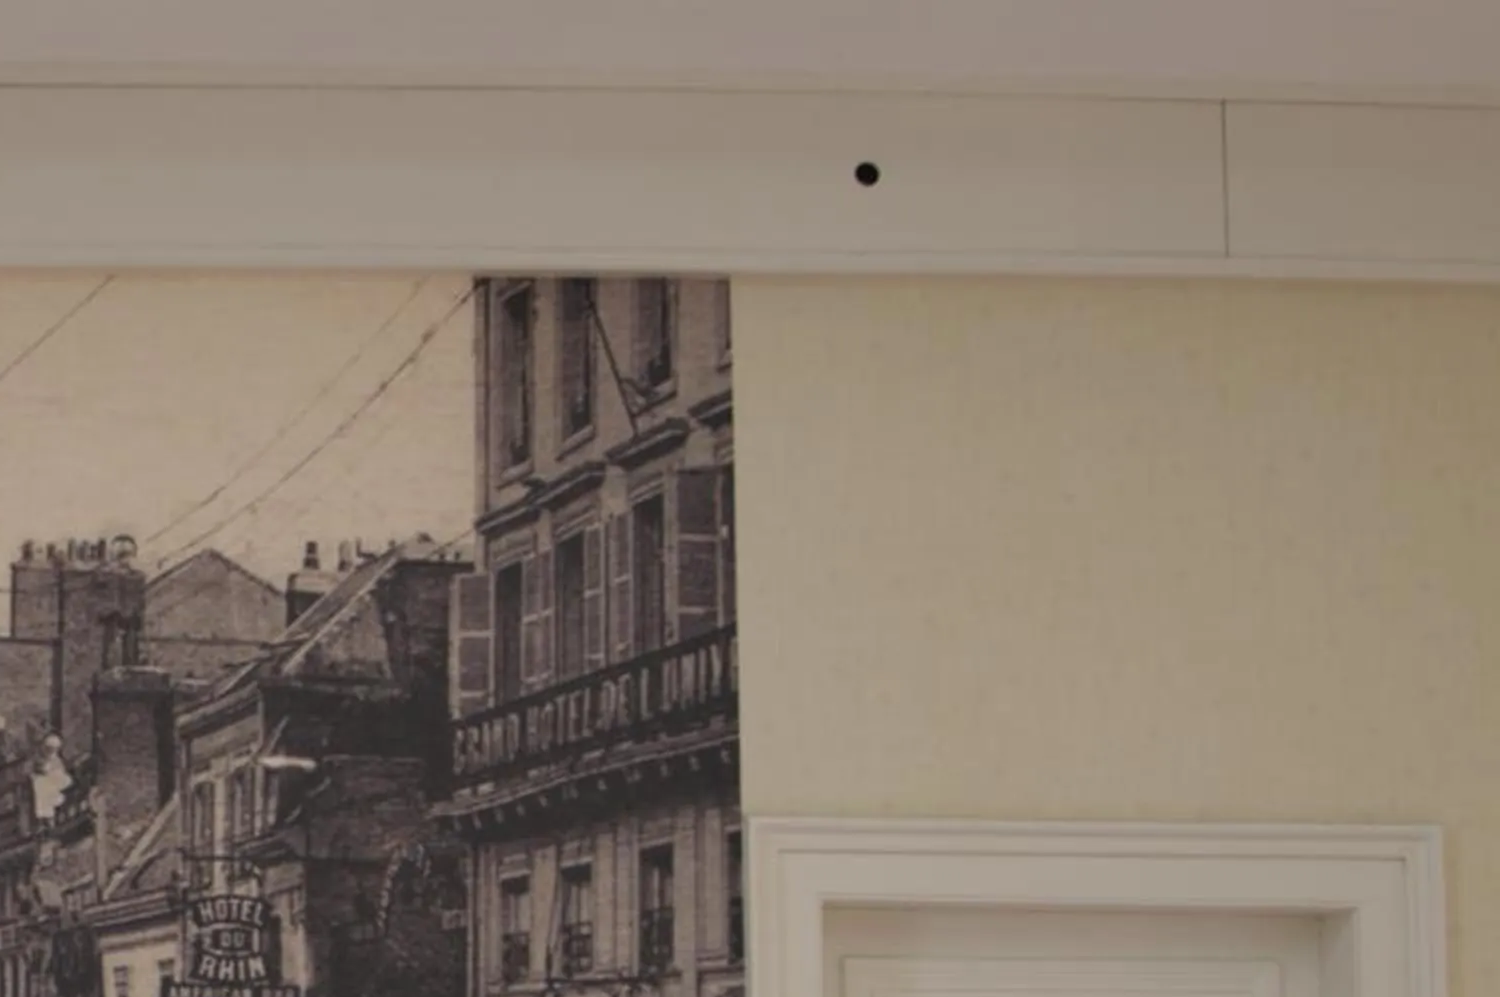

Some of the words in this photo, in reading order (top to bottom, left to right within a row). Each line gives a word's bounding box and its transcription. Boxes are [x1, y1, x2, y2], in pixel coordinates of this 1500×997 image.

[527, 688, 594, 755] HOTEL
[197, 898, 264, 927] HOTEL
[220, 932, 246, 948] DU
[198, 954, 267, 982] RHIN
